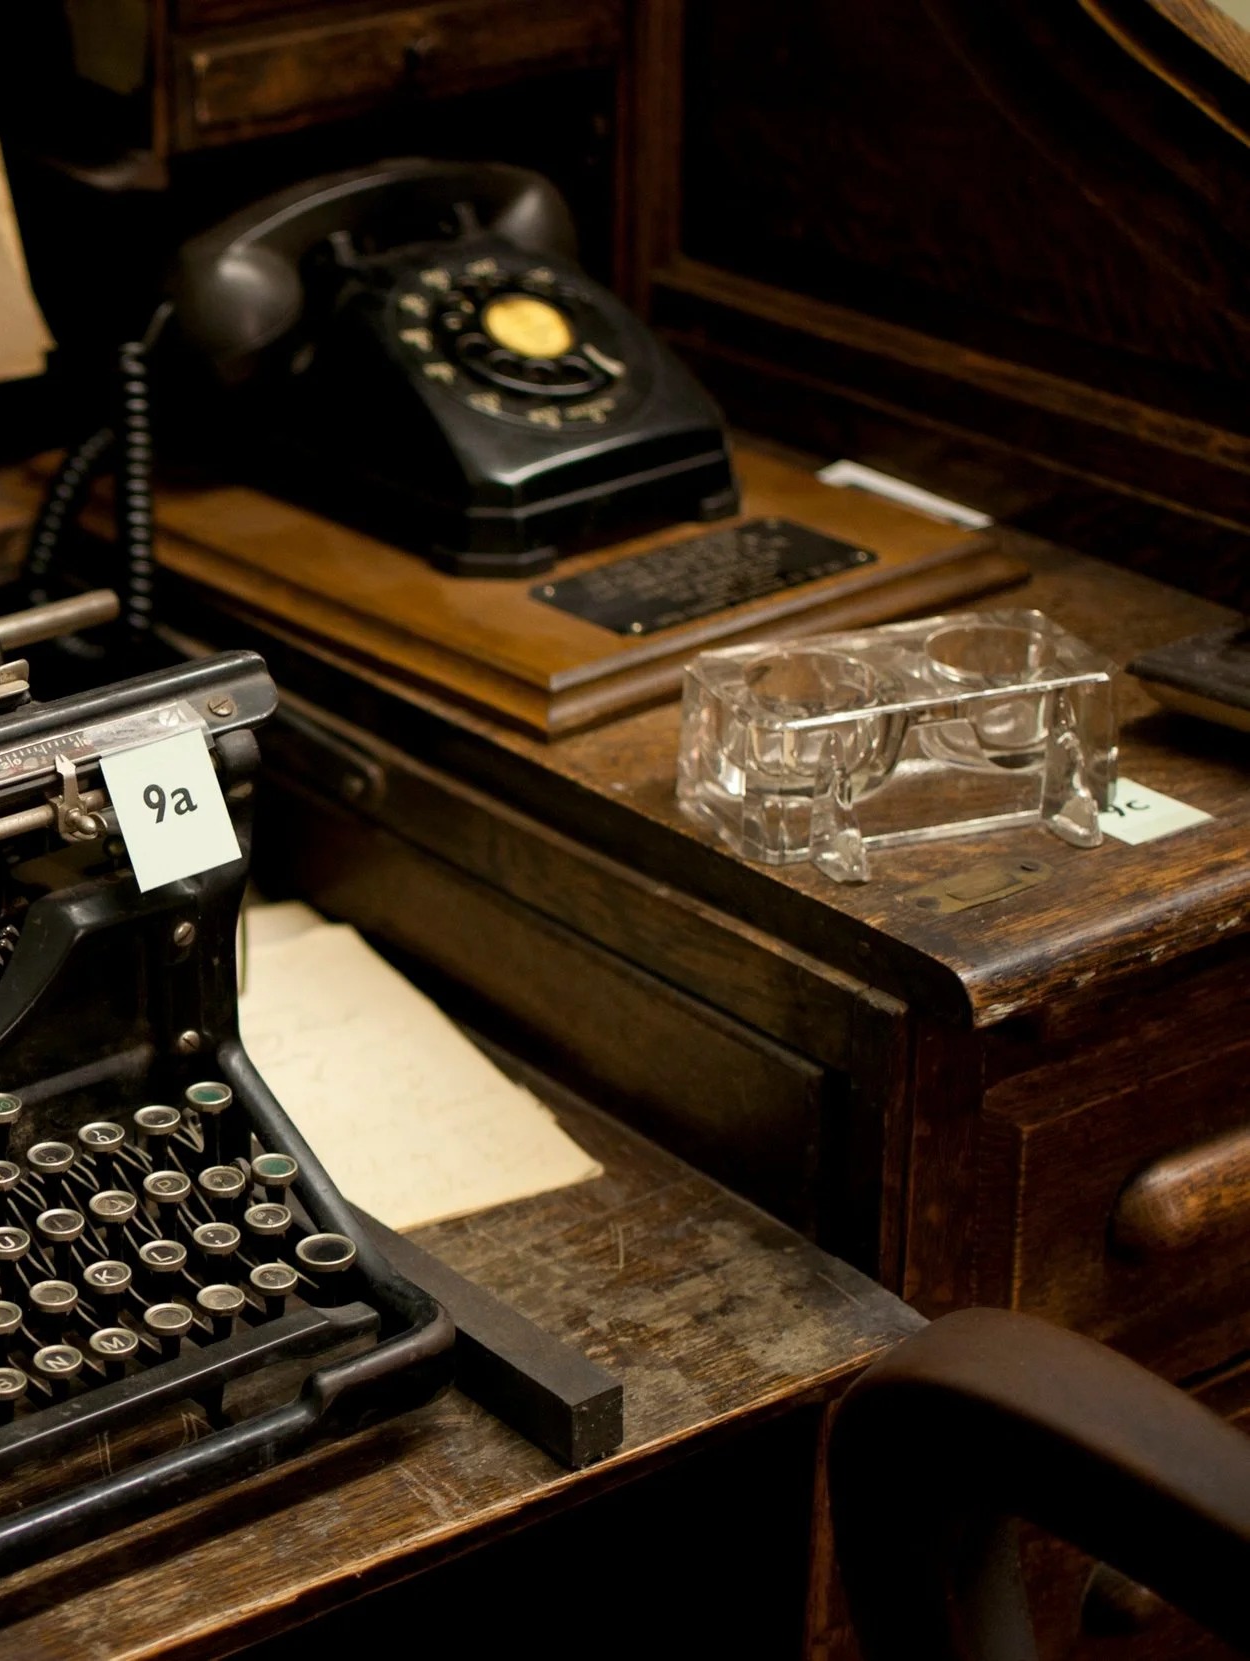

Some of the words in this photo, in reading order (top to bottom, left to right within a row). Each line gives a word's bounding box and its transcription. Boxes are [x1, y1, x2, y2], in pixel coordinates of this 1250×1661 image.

[143, 784, 198, 824] 9a
[156, 1180, 171, 1193] P
[151, 1251, 173, 1263] L
[95, 1270, 119, 1283] K
[100, 1336, 125, 1351] M
[46, 1356, 71, 1370] N
